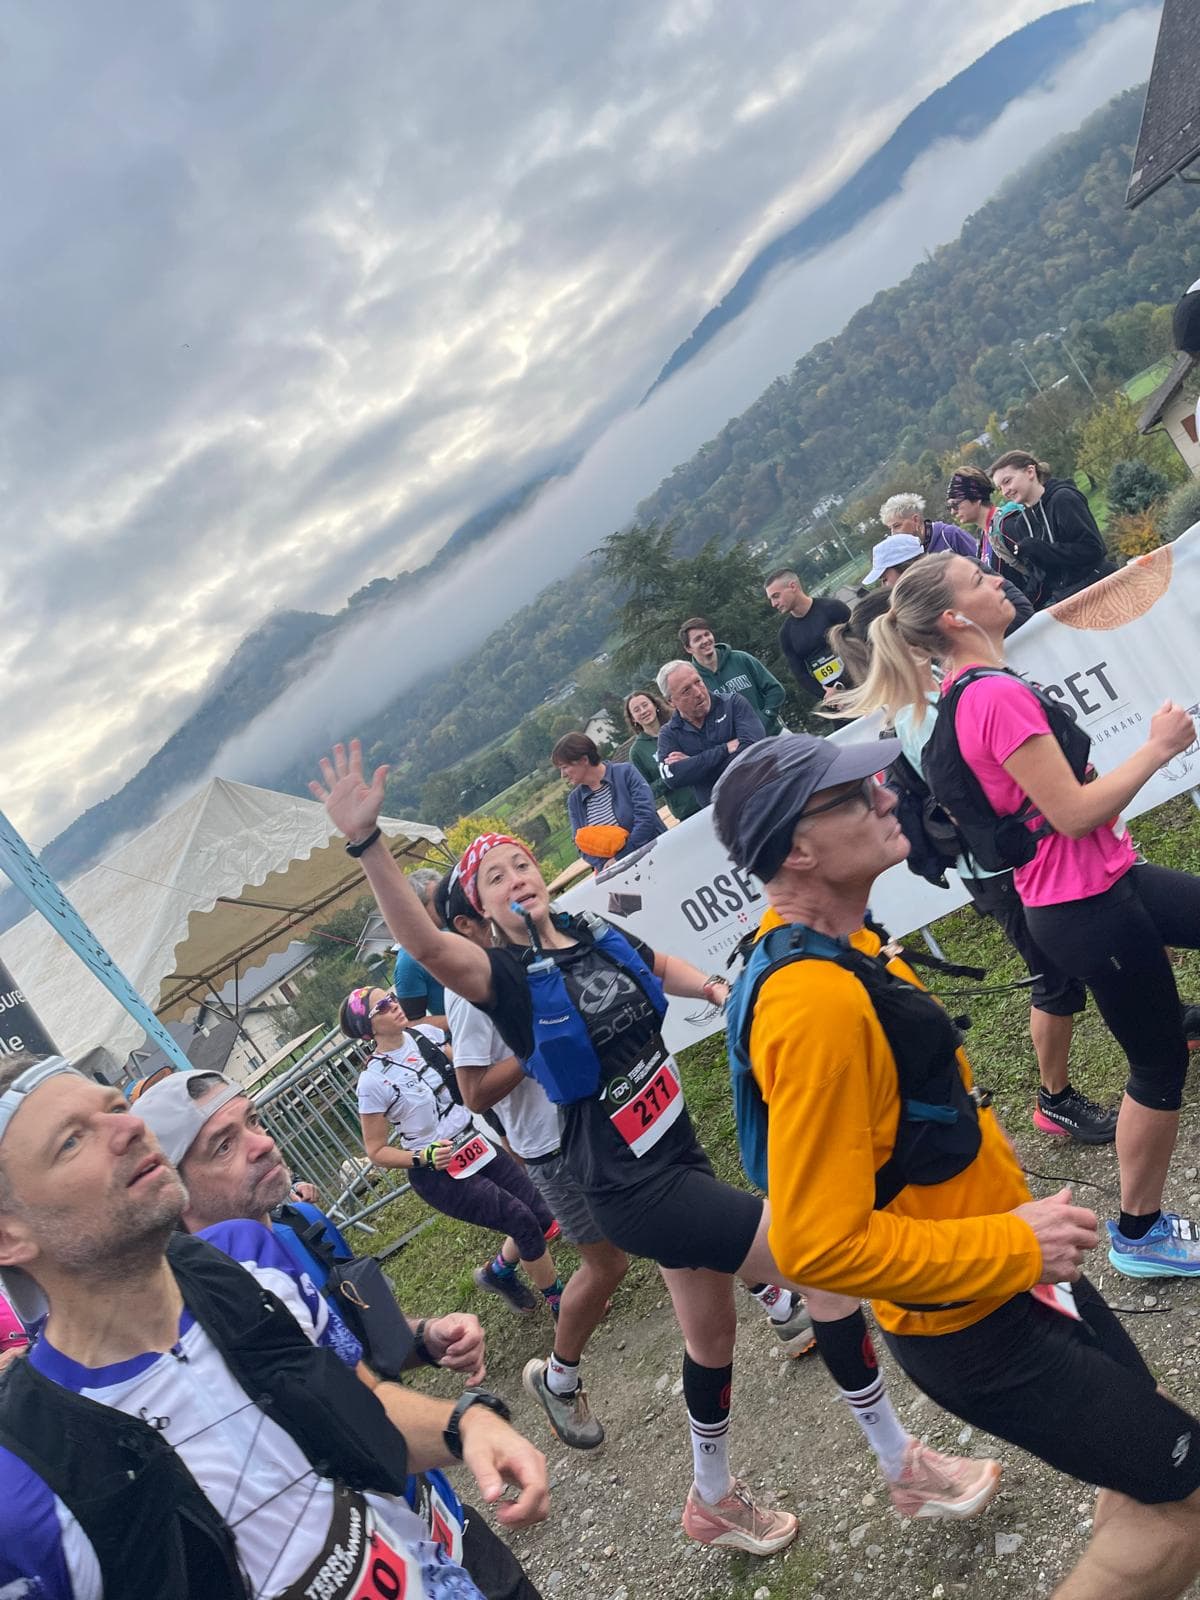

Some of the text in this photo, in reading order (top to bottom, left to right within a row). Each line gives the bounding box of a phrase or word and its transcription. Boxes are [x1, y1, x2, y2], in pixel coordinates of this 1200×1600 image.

[820, 664, 835, 678] 69
[1042, 661, 1119, 722] SET
[1090, 711, 1144, 746] OURMAND
[680, 865, 762, 932] ORSE
[611, 1080, 631, 1100] TDR
[632, 1075, 672, 1128] 277
[1041, 1107, 1080, 1129] MERRELL
[455, 1142, 483, 1169] 308
[303, 1543, 345, 1600] TERRE
